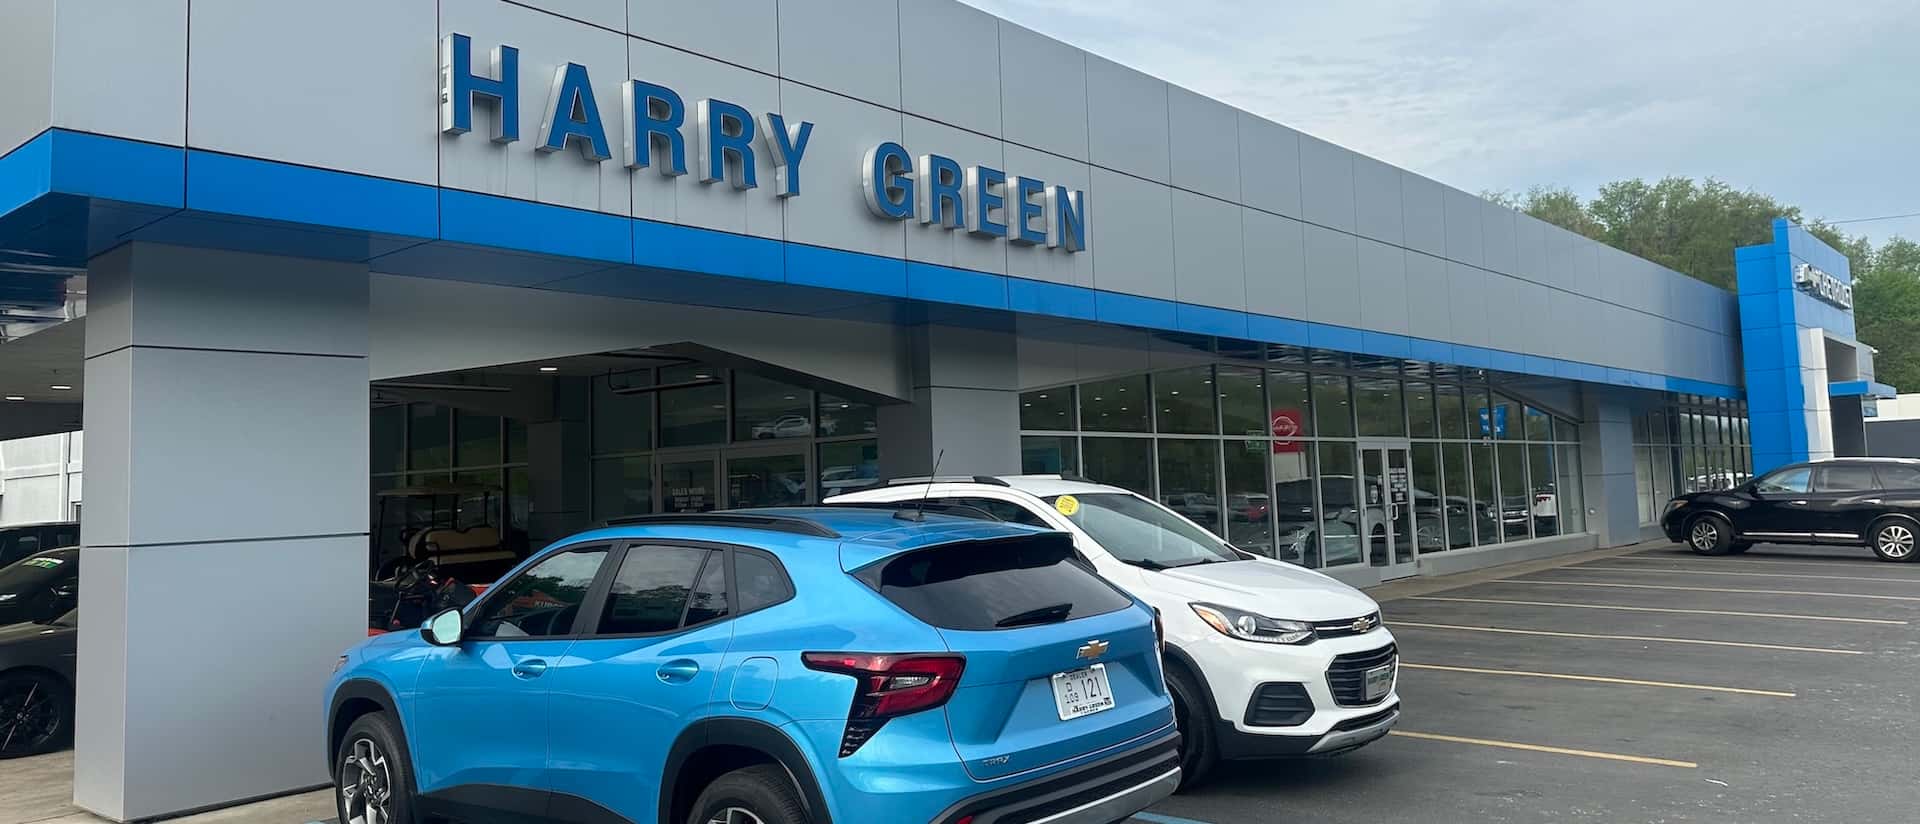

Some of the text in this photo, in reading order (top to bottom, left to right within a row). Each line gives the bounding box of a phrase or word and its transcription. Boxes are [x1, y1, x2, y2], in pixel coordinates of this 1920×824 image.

[442, 33, 1087, 253] HARRY GREEN
[1081, 676, 1102, 700] 121
